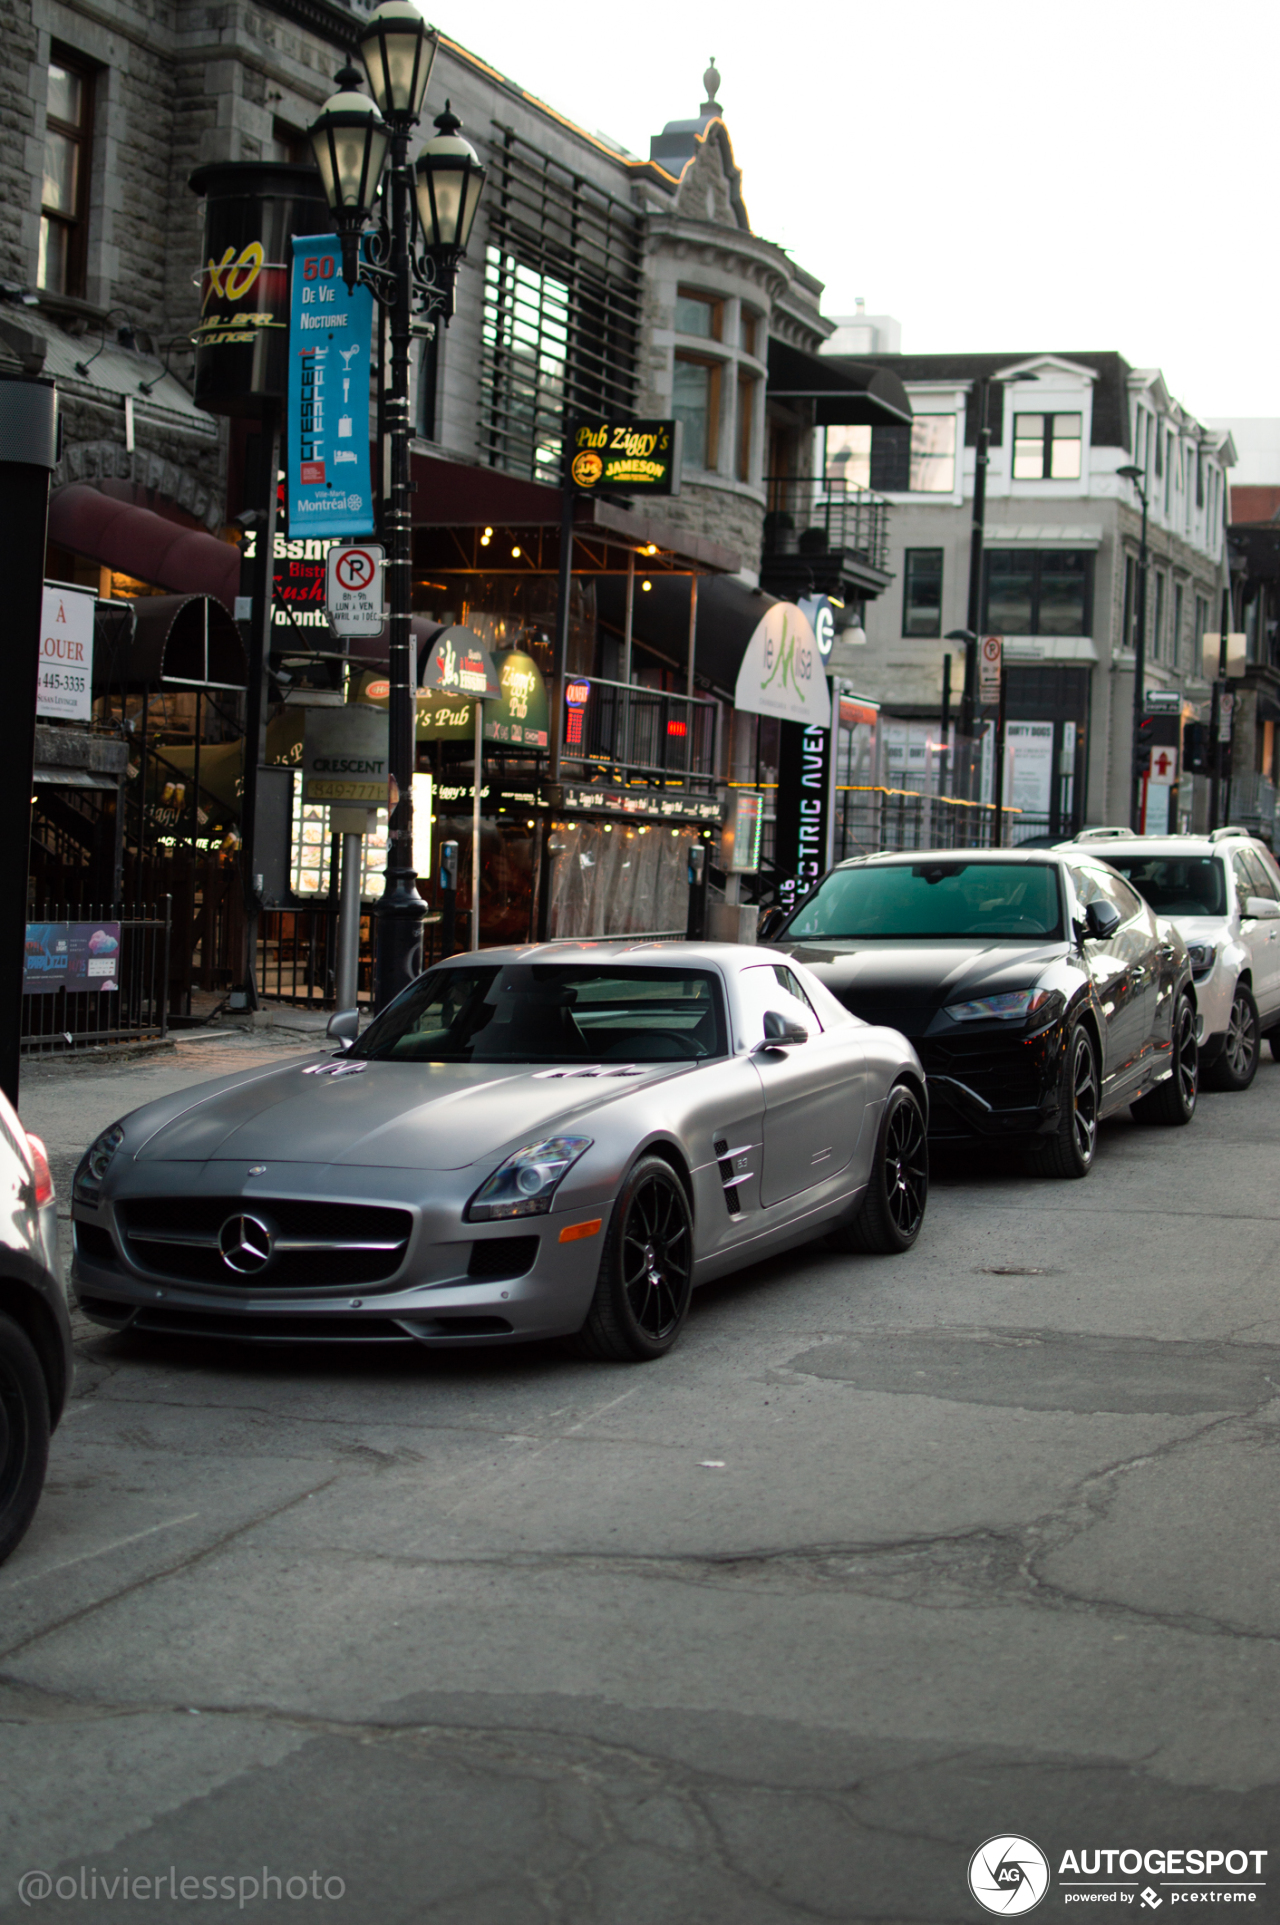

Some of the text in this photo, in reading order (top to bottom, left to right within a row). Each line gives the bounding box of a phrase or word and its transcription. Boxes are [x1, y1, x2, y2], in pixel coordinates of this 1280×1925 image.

[303, 255, 335, 280] 50
[230, 313, 274, 325] BAR
[576, 424, 670, 457] Pub Ziggy's
[605, 459, 665, 478] JAMESON
[315, 490, 346, 498] Ville-Marie
[298, 498, 347, 512] Montréal
[56, 599, 67, 624] À
[335, 602, 349, 611] LUN
[359, 601, 373, 611] VEN
[334, 612, 350, 620] AVRIL
[43, 672, 85, 693] 445-3335
[501, 665, 536, 699] Ziggy's
[435, 705, 470, 727] Pub
[509, 696, 528, 719] Pub
[1008, 726, 1051, 737] DIRTY DOGS
[312, 758, 385, 774] CRESCENT
